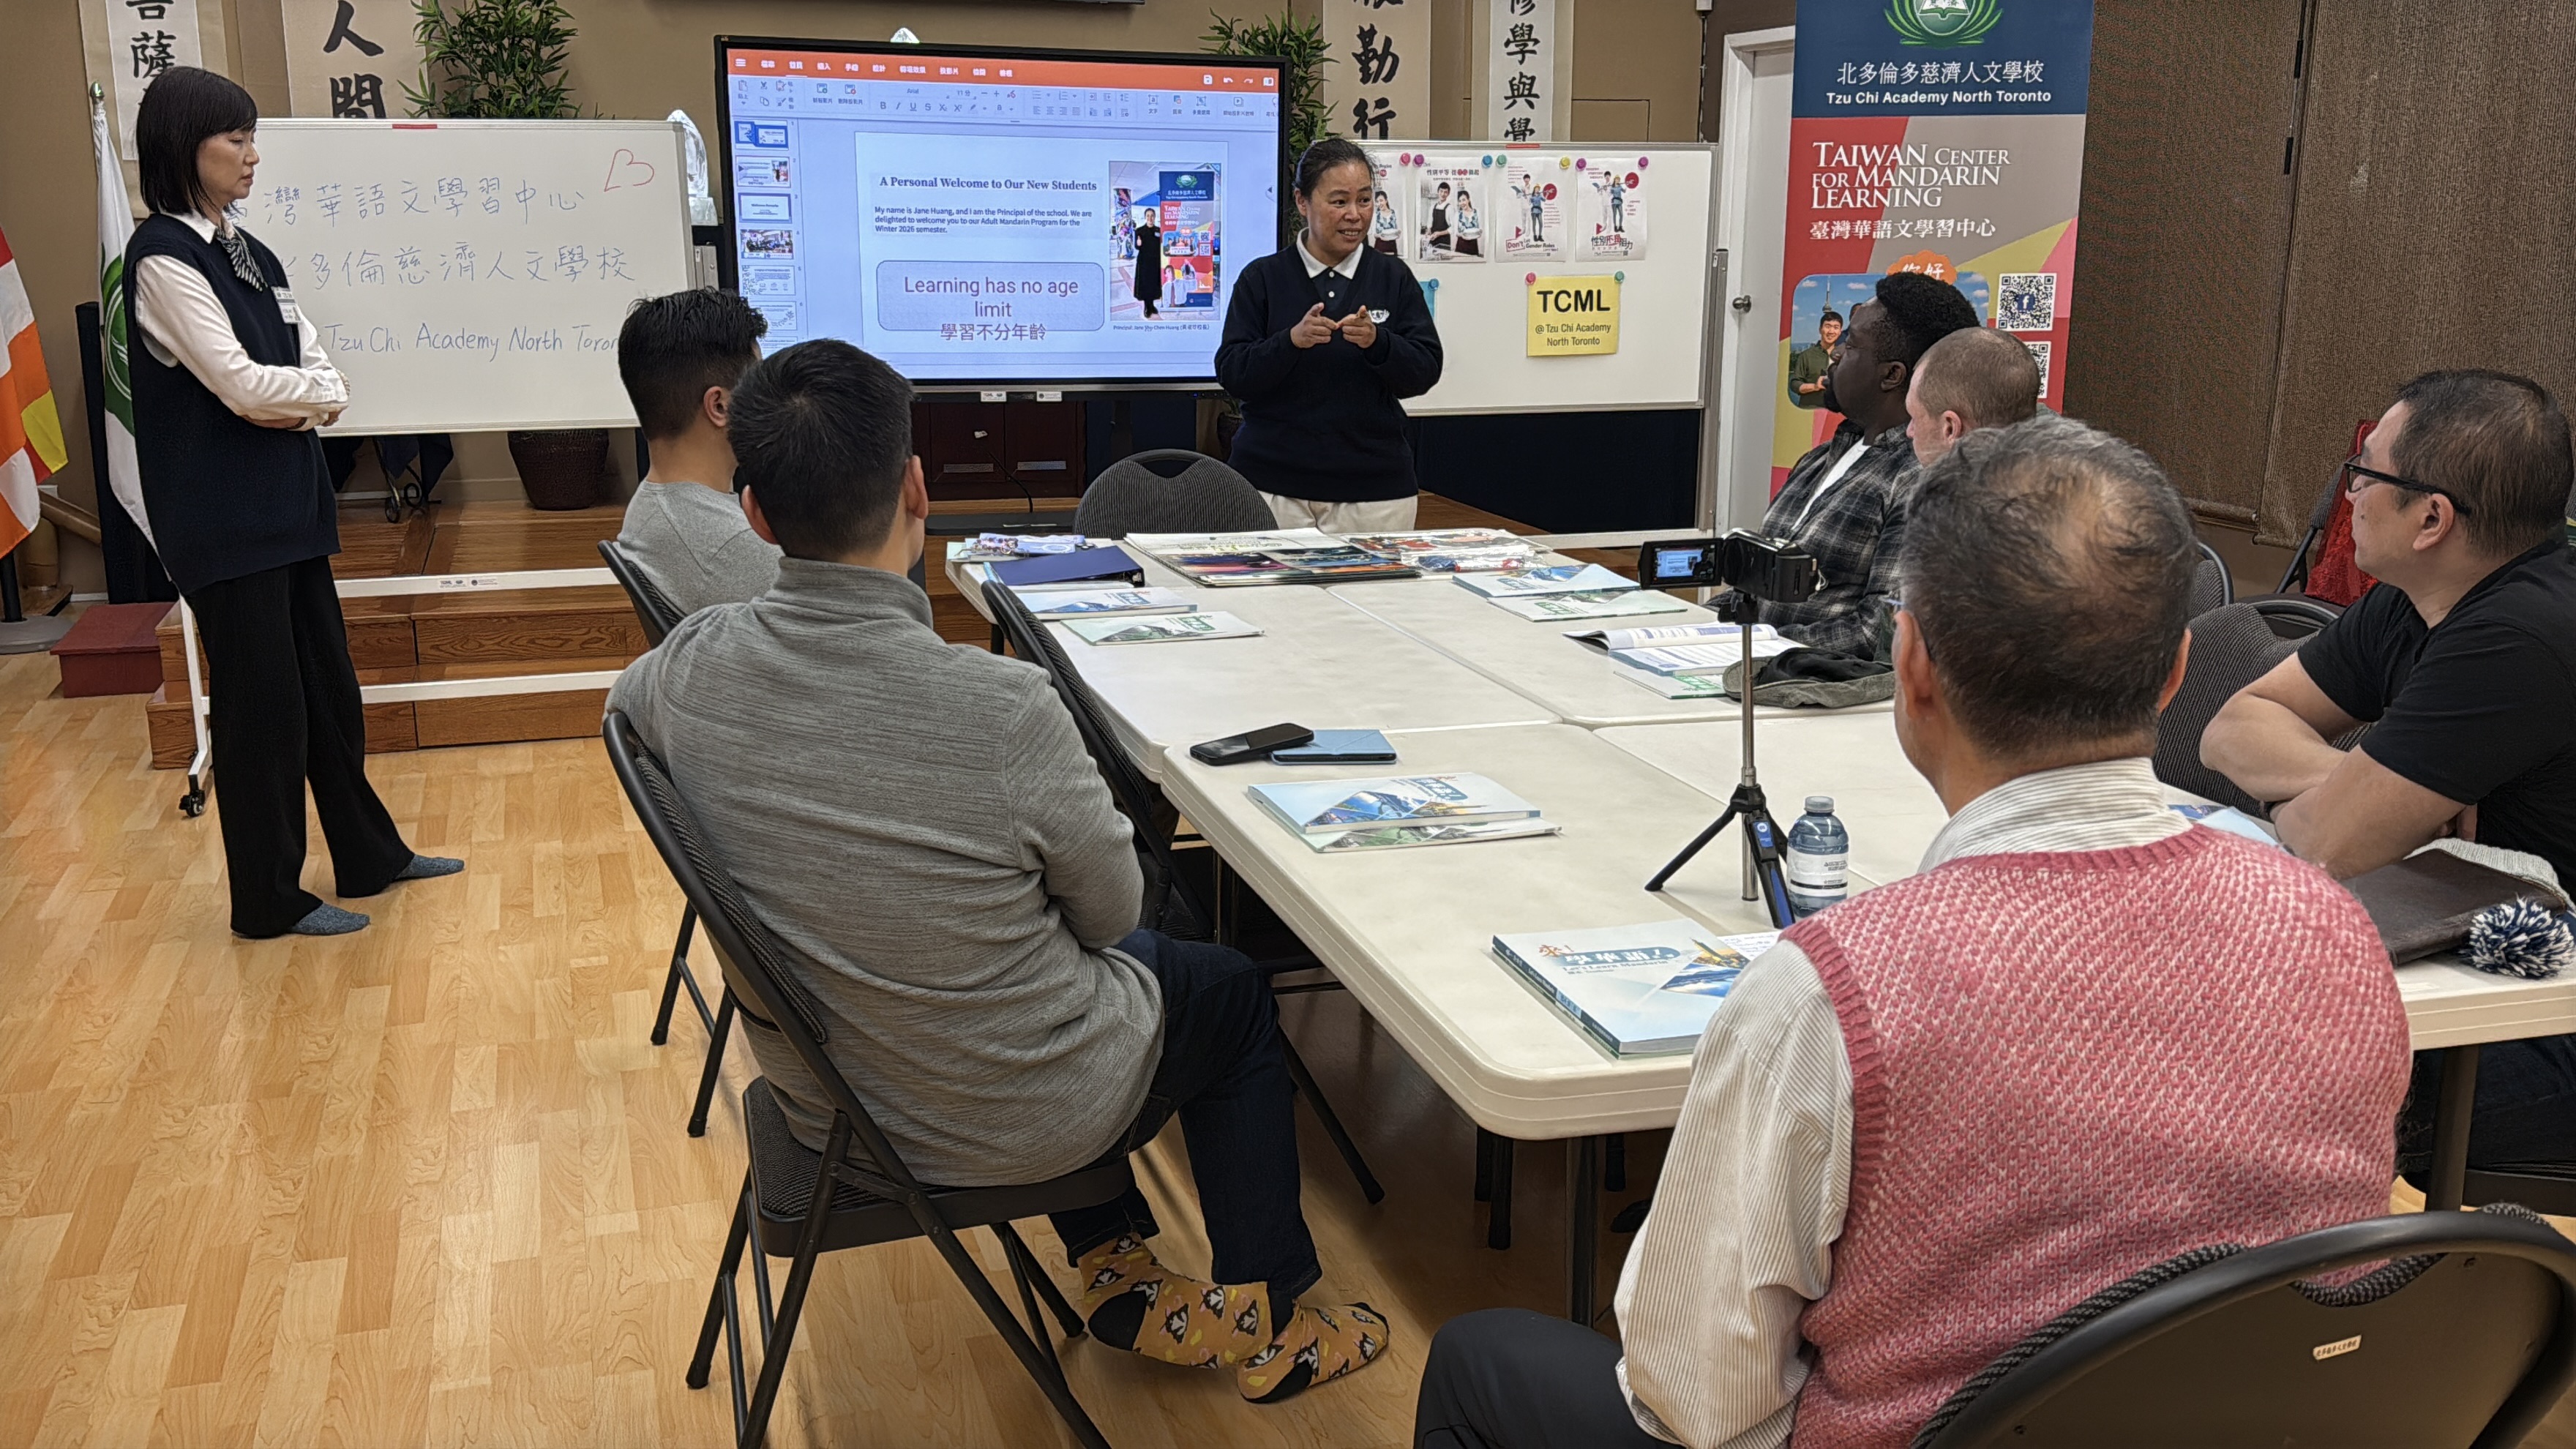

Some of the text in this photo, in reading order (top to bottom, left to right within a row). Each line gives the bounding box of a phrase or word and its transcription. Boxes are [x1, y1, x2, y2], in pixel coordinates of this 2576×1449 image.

[1351, 0, 1404, 140] 勤行
[1837, 60, 2044, 86] 北多倫多慈濟人文學校
[1826, 89, 2051, 105] Tzu Chi Academy North Toronto
[1813, 142, 2011, 168] TAIWAN CENTER
[880, 176, 1097, 190] A Personal Welcome to Our New Students
[1811, 165, 2002, 188] FOR MANDARIN
[1811, 187, 1942, 209] LEARNING
[875, 206, 885, 214] My
[931, 208, 954, 216] Huang,
[997, 209, 1025, 217] Principal
[875, 216, 907, 225] delighted
[1031, 219, 1058, 227] Program
[1810, 218, 1996, 240] 臺灣華語文學習中心
[905, 277, 1079, 297] Learning has no age
[975, 301, 1012, 317] limit
[1537, 289, 1611, 313] TCML
[940, 323, 1046, 341] 學習不分年齡
[1535, 323, 1611, 334] @ Tzu Chi Academy
[324, 323, 364, 351] Tzu
[370, 326, 400, 352] Chi
[416, 322, 499, 362] Academy
[509, 326, 562, 351] North
[1547, 336, 1600, 346] North Toronto
